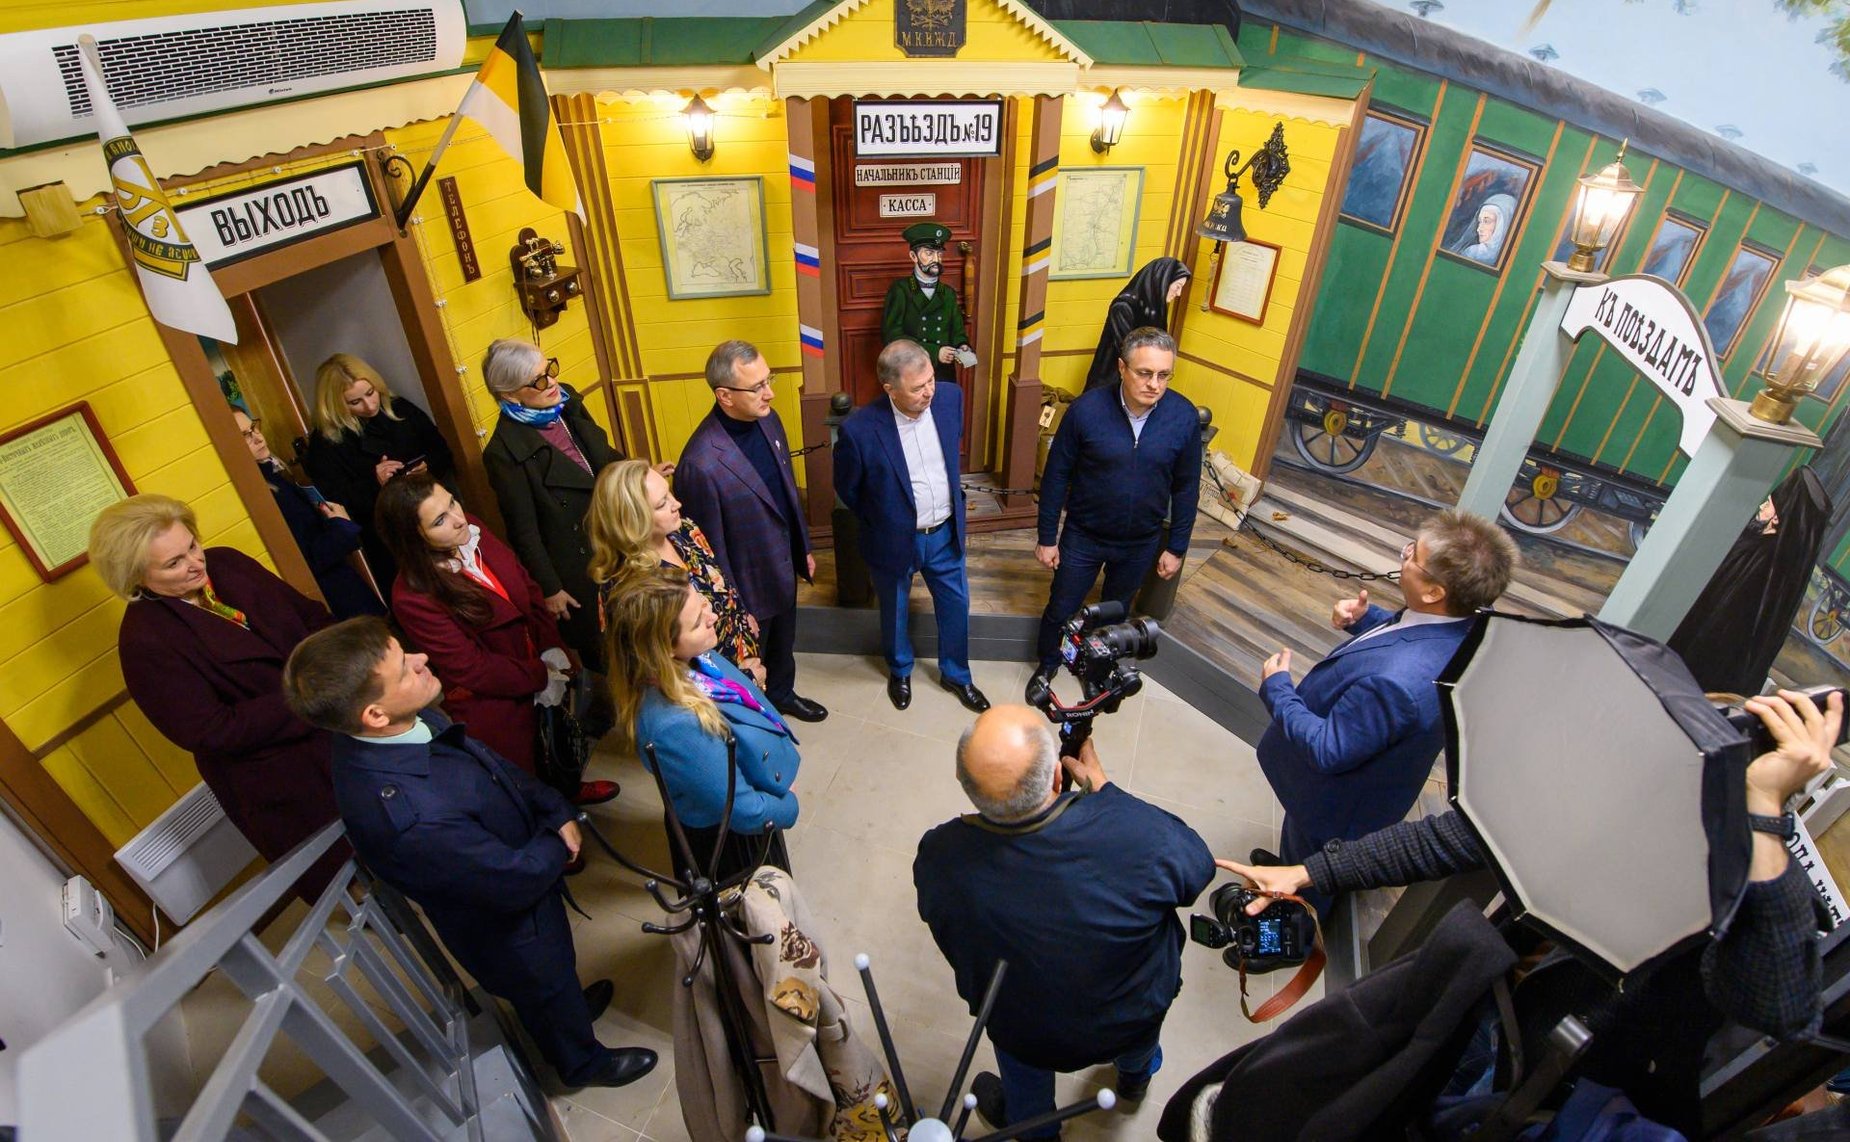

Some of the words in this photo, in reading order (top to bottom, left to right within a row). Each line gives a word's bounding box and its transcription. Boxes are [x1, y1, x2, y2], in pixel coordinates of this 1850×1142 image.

[856, 168, 918, 182] НАЧАЛЬНИКЪ
[888, 199, 927, 212] КАССА
[210, 184, 331, 248] ВЫХОДЪ
[444, 180, 476, 275] ТЕЛЕФОНЪ
[1594, 287, 1619, 329] КЪ
[1613, 302, 1703, 397] ПОѢЗДАМЪ
